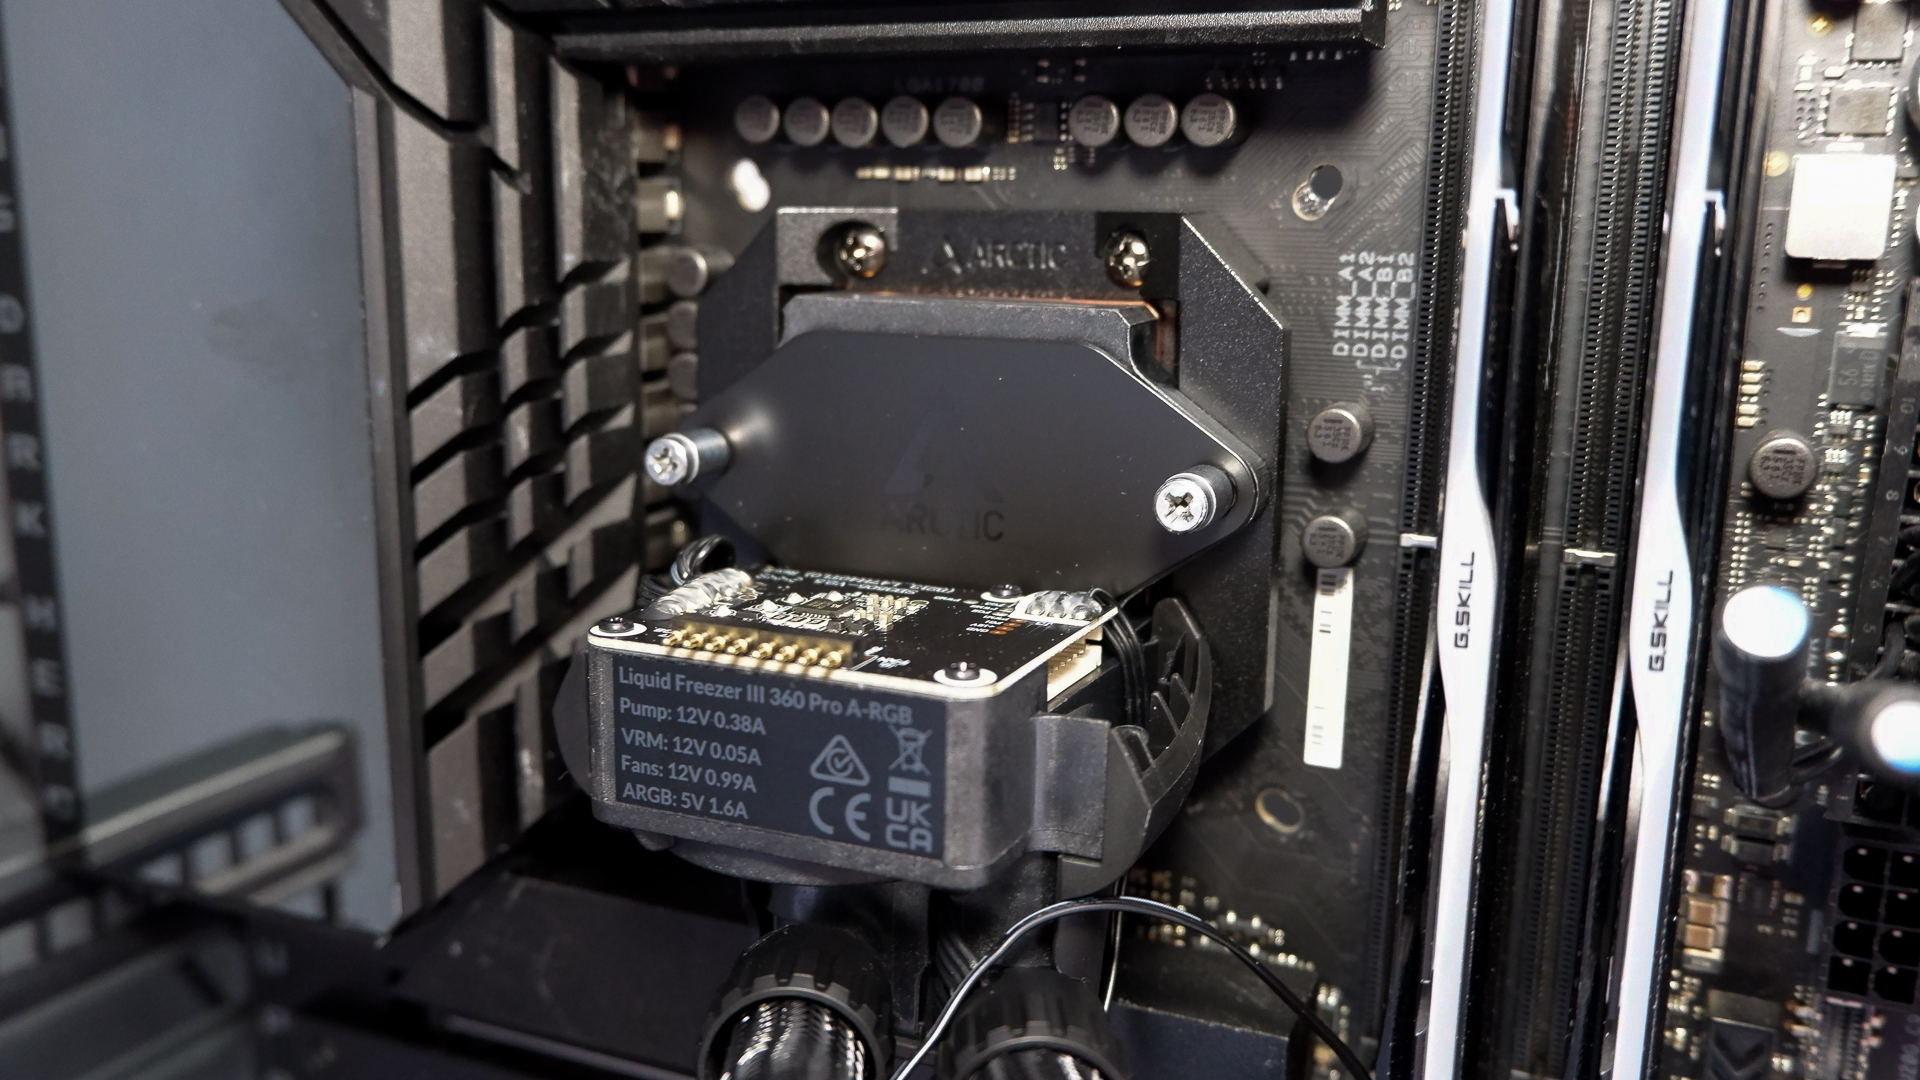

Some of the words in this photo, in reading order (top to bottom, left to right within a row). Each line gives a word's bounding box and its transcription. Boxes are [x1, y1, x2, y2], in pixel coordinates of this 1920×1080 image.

[965, 238, 1068, 272] ARCTIC
[1332, 252, 1358, 357] DIMM_A1
[1351, 251, 1377, 358] DIMM_A2
[1371, 254, 1398, 359] DIMM_B1
[1390, 252, 1416, 360] DIMM_B2
[1453, 551, 1475, 649] G.SKILL
[1648, 569, 1673, 672] G.SKILL
[619, 666, 672, 690] Liquid
[674, 673, 743, 700] Freezer
[746, 683, 766, 704] III
[769, 687, 806, 710] 360
[808, 692, 843, 715] Pro
[845, 697, 914, 726] A-RGB
[619, 696, 673, 723] Pump:
[676, 705, 712, 727] 12V
[713, 711, 767, 736] 0.38A
[621, 727, 669, 751] VRM:
[672, 735, 707, 757] 12V
[709, 742, 763, 767] 0.05A
[621, 754, 664, 778] Fans:
[667, 762, 703, 784] 12V
[704, 768, 758, 794] 0.99A
[622, 782, 678, 807] ARGB:
[680, 791, 705, 812] 5V
[709, 797, 749, 820] 1.6A
